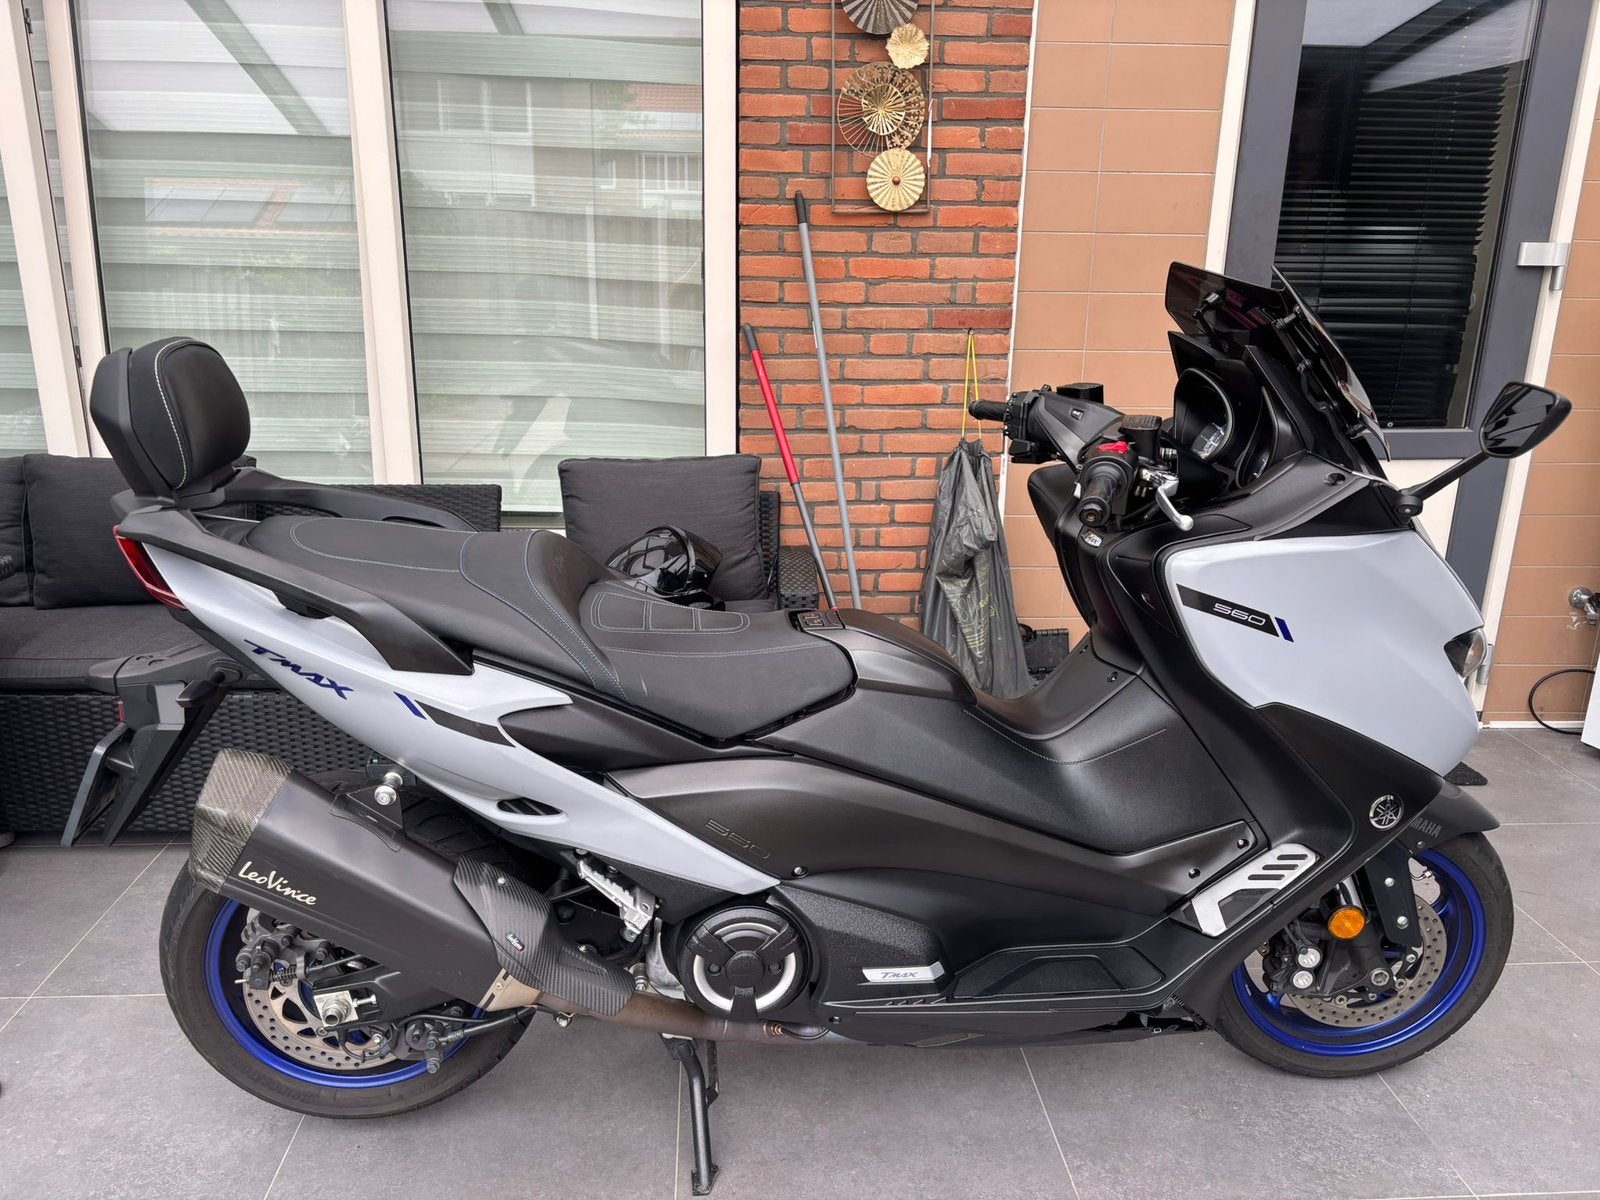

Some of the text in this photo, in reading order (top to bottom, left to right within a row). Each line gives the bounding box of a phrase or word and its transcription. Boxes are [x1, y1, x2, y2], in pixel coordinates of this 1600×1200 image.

[1213, 602, 1266, 626] 560
[243, 639, 355, 701] TMAX
[1409, 816, 1442, 838] MAHA
[238, 861, 317, 905] LeoVince
